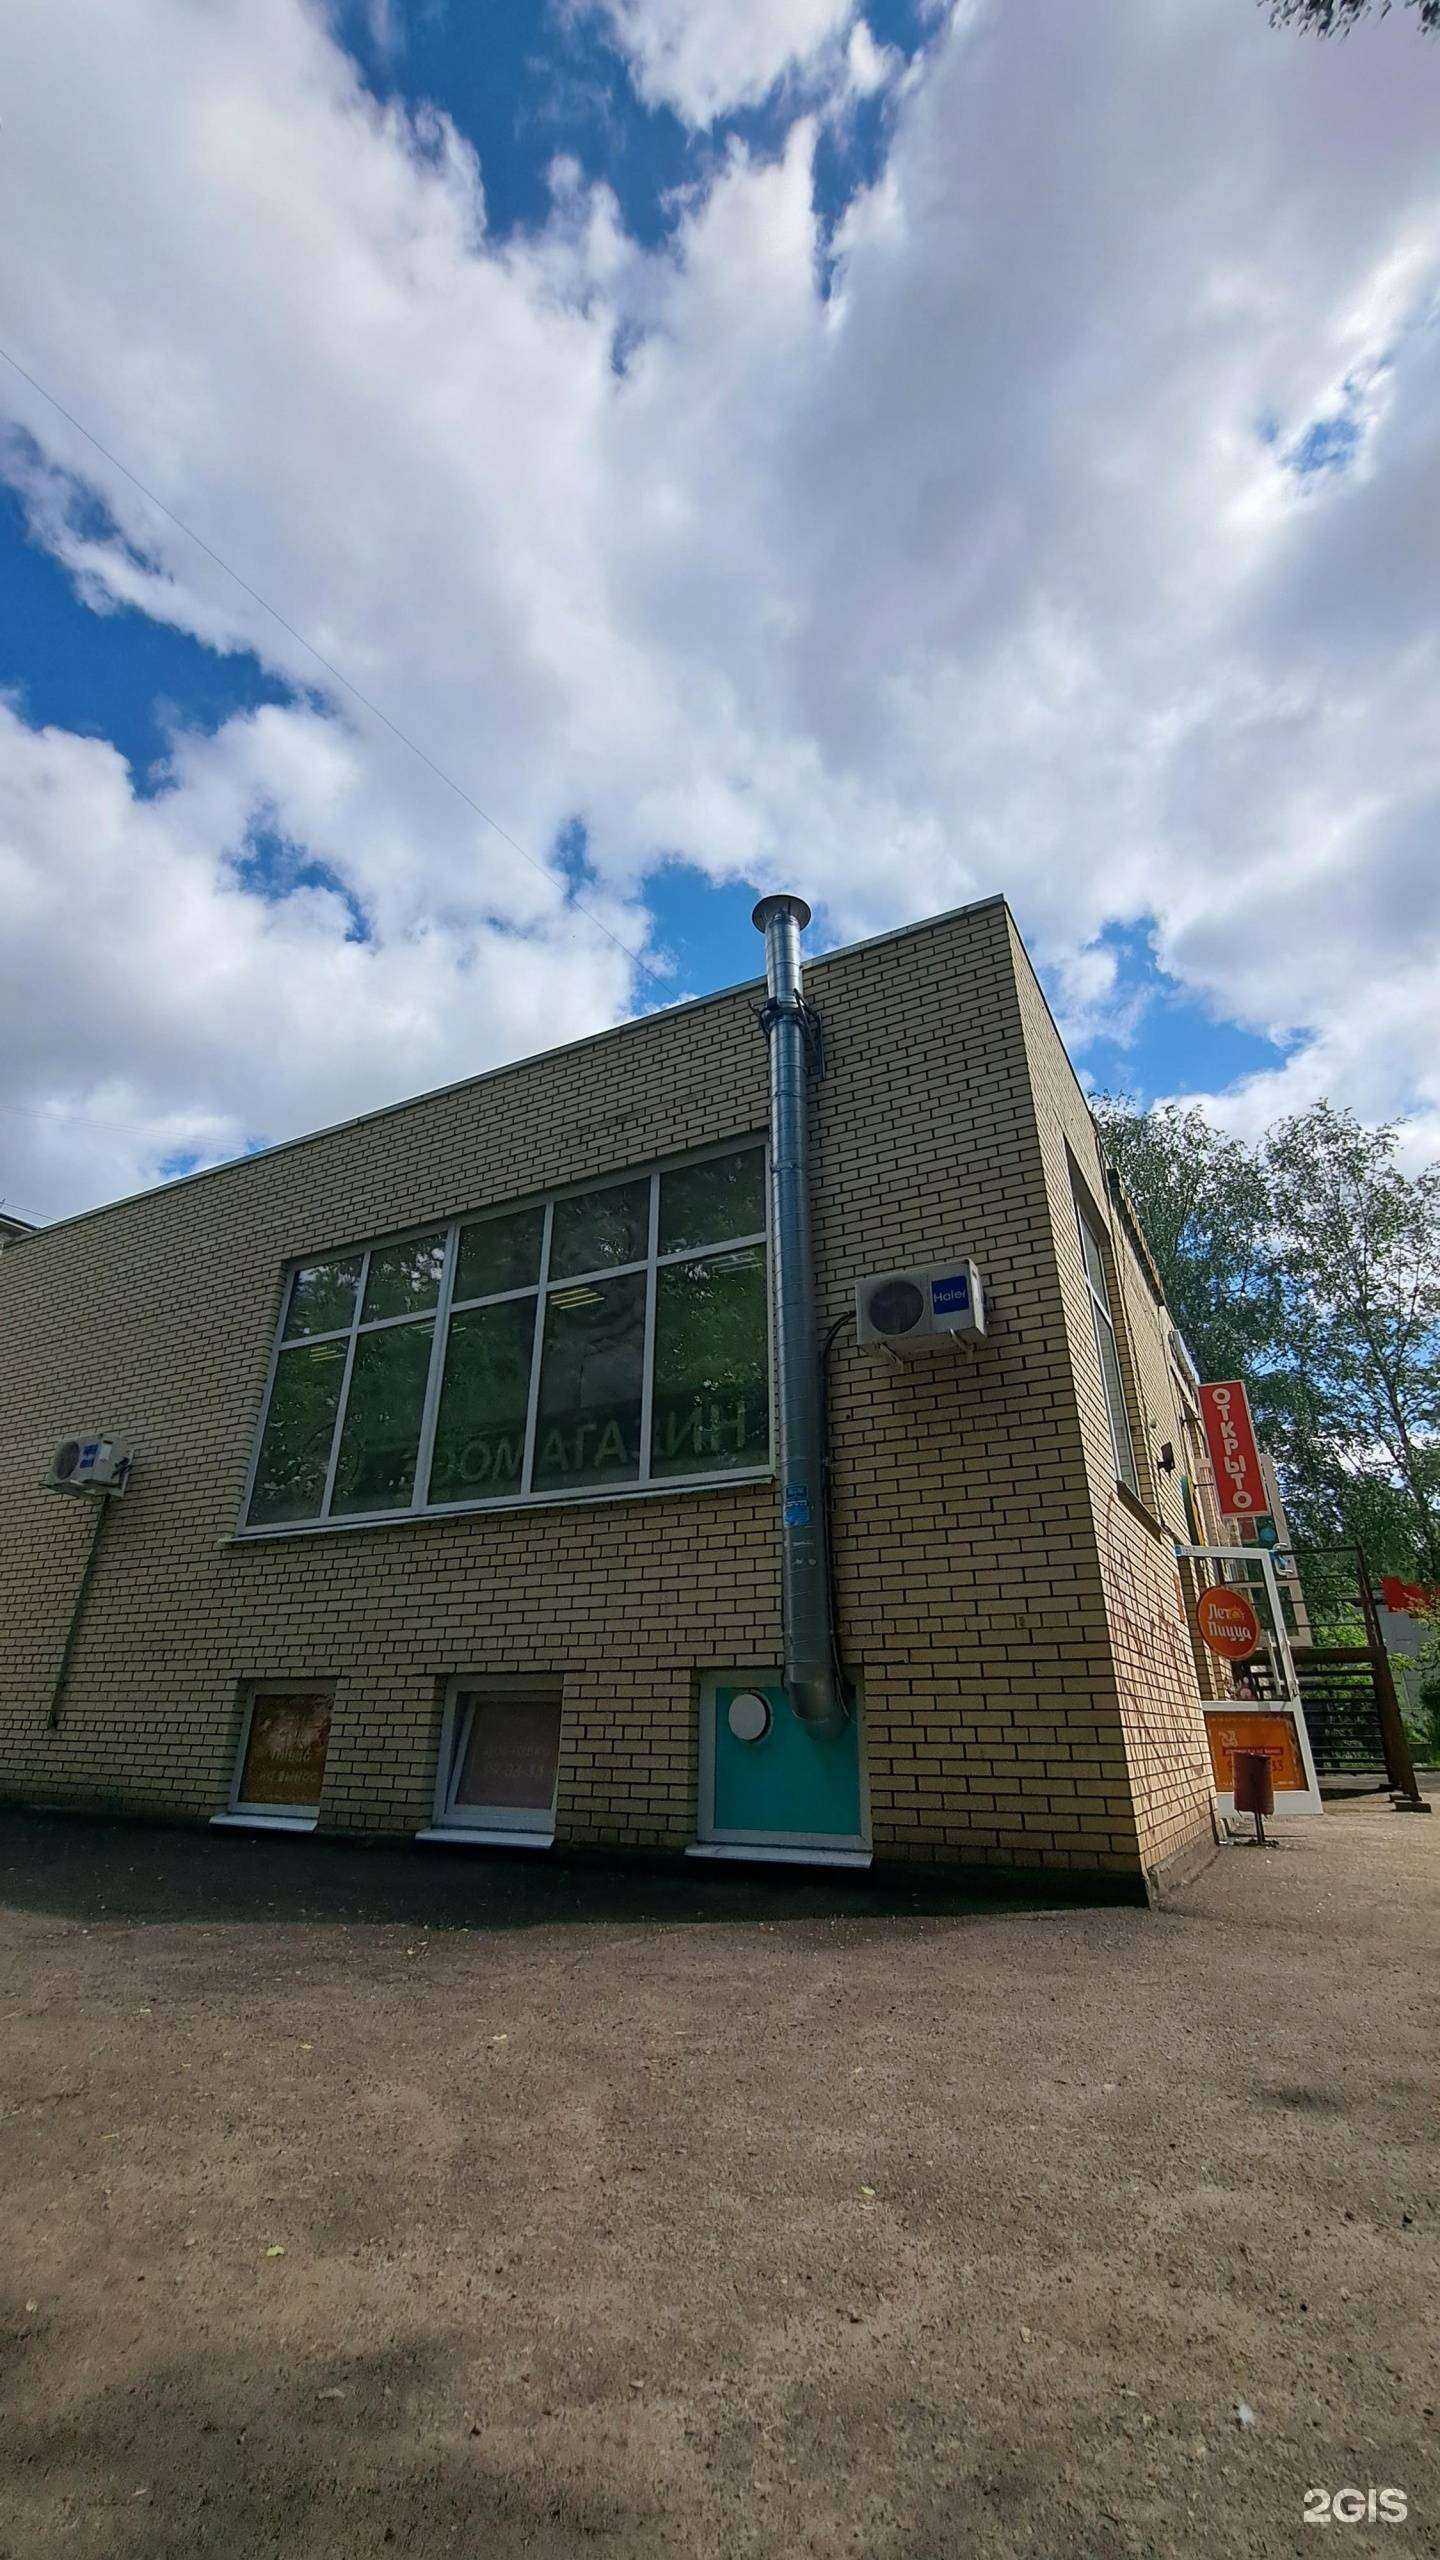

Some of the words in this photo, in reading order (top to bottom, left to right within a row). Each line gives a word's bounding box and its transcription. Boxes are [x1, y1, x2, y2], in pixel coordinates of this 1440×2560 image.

[933, 1289, 967, 1303] Haier
[1211, 1387, 1253, 1509] ОТКРЫТО
[1208, 1621, 1252, 1642] Пицца
